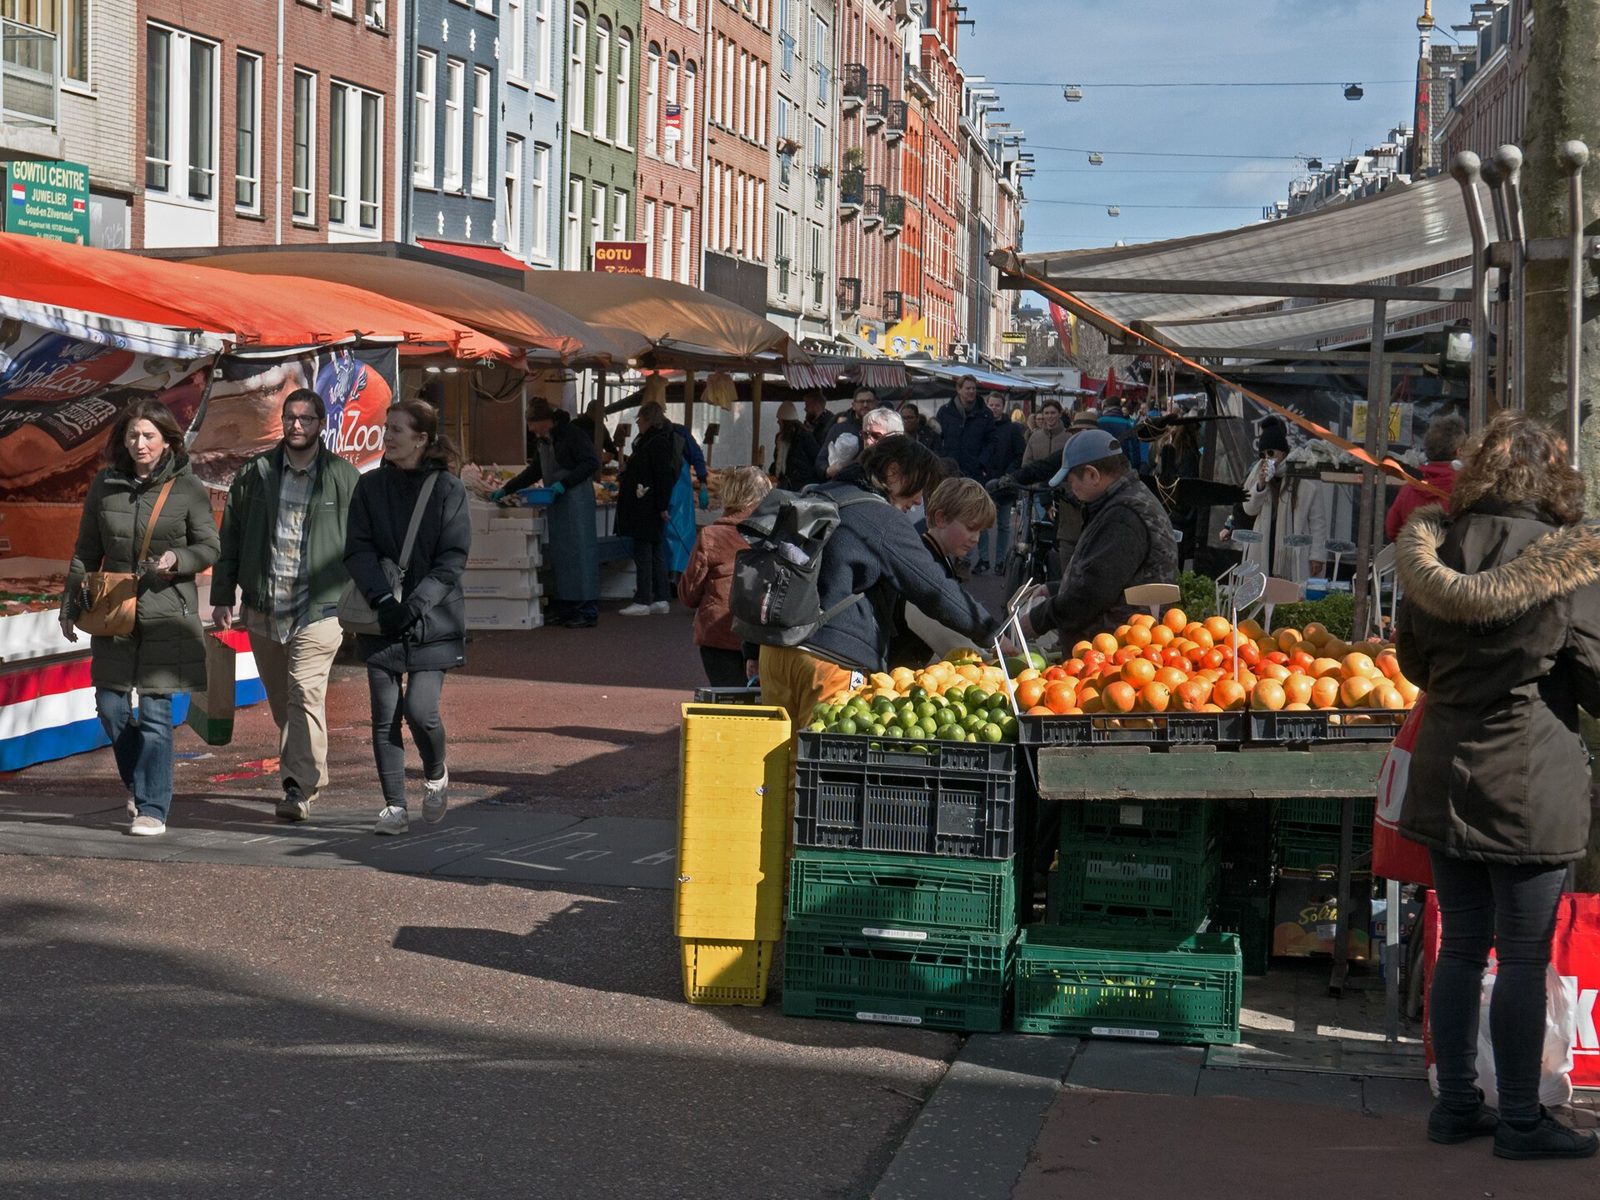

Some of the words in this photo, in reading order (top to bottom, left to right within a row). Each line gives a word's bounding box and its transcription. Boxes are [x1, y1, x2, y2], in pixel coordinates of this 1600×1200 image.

[13, 160, 48, 185] GOWTU
[48, 166, 85, 192] CENTRE
[31, 188, 68, 206] JUWELIER
[596, 248, 632, 260] GOTU
